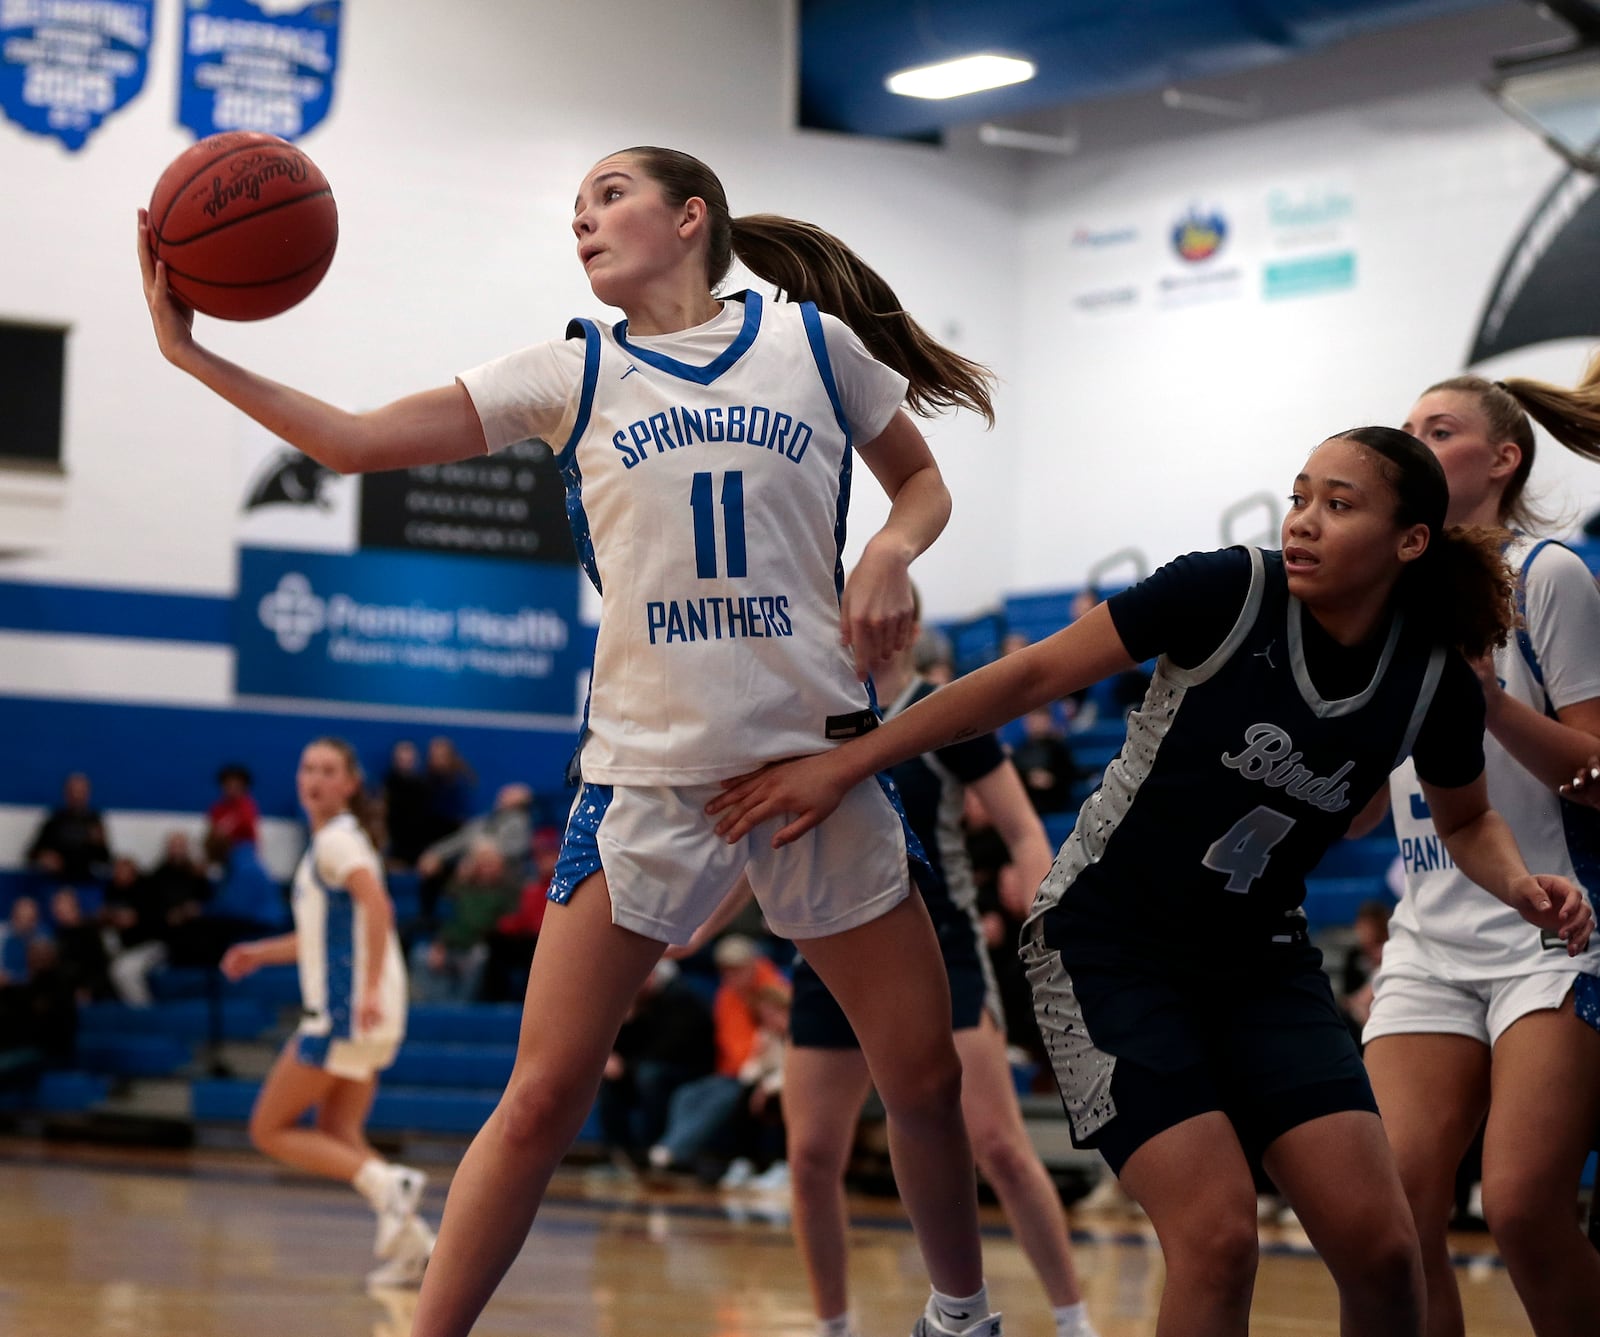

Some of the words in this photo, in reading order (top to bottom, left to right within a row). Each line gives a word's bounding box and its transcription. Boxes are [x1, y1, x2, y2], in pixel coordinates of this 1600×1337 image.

[203, 154, 308, 218] Rawlings
[612, 405, 813, 470] SPRINGBORO
[689, 470, 747, 579] 11
[647, 595, 793, 645] PANTHERS
[1221, 722, 1356, 813] Birds
[1201, 805, 1297, 894] 4
